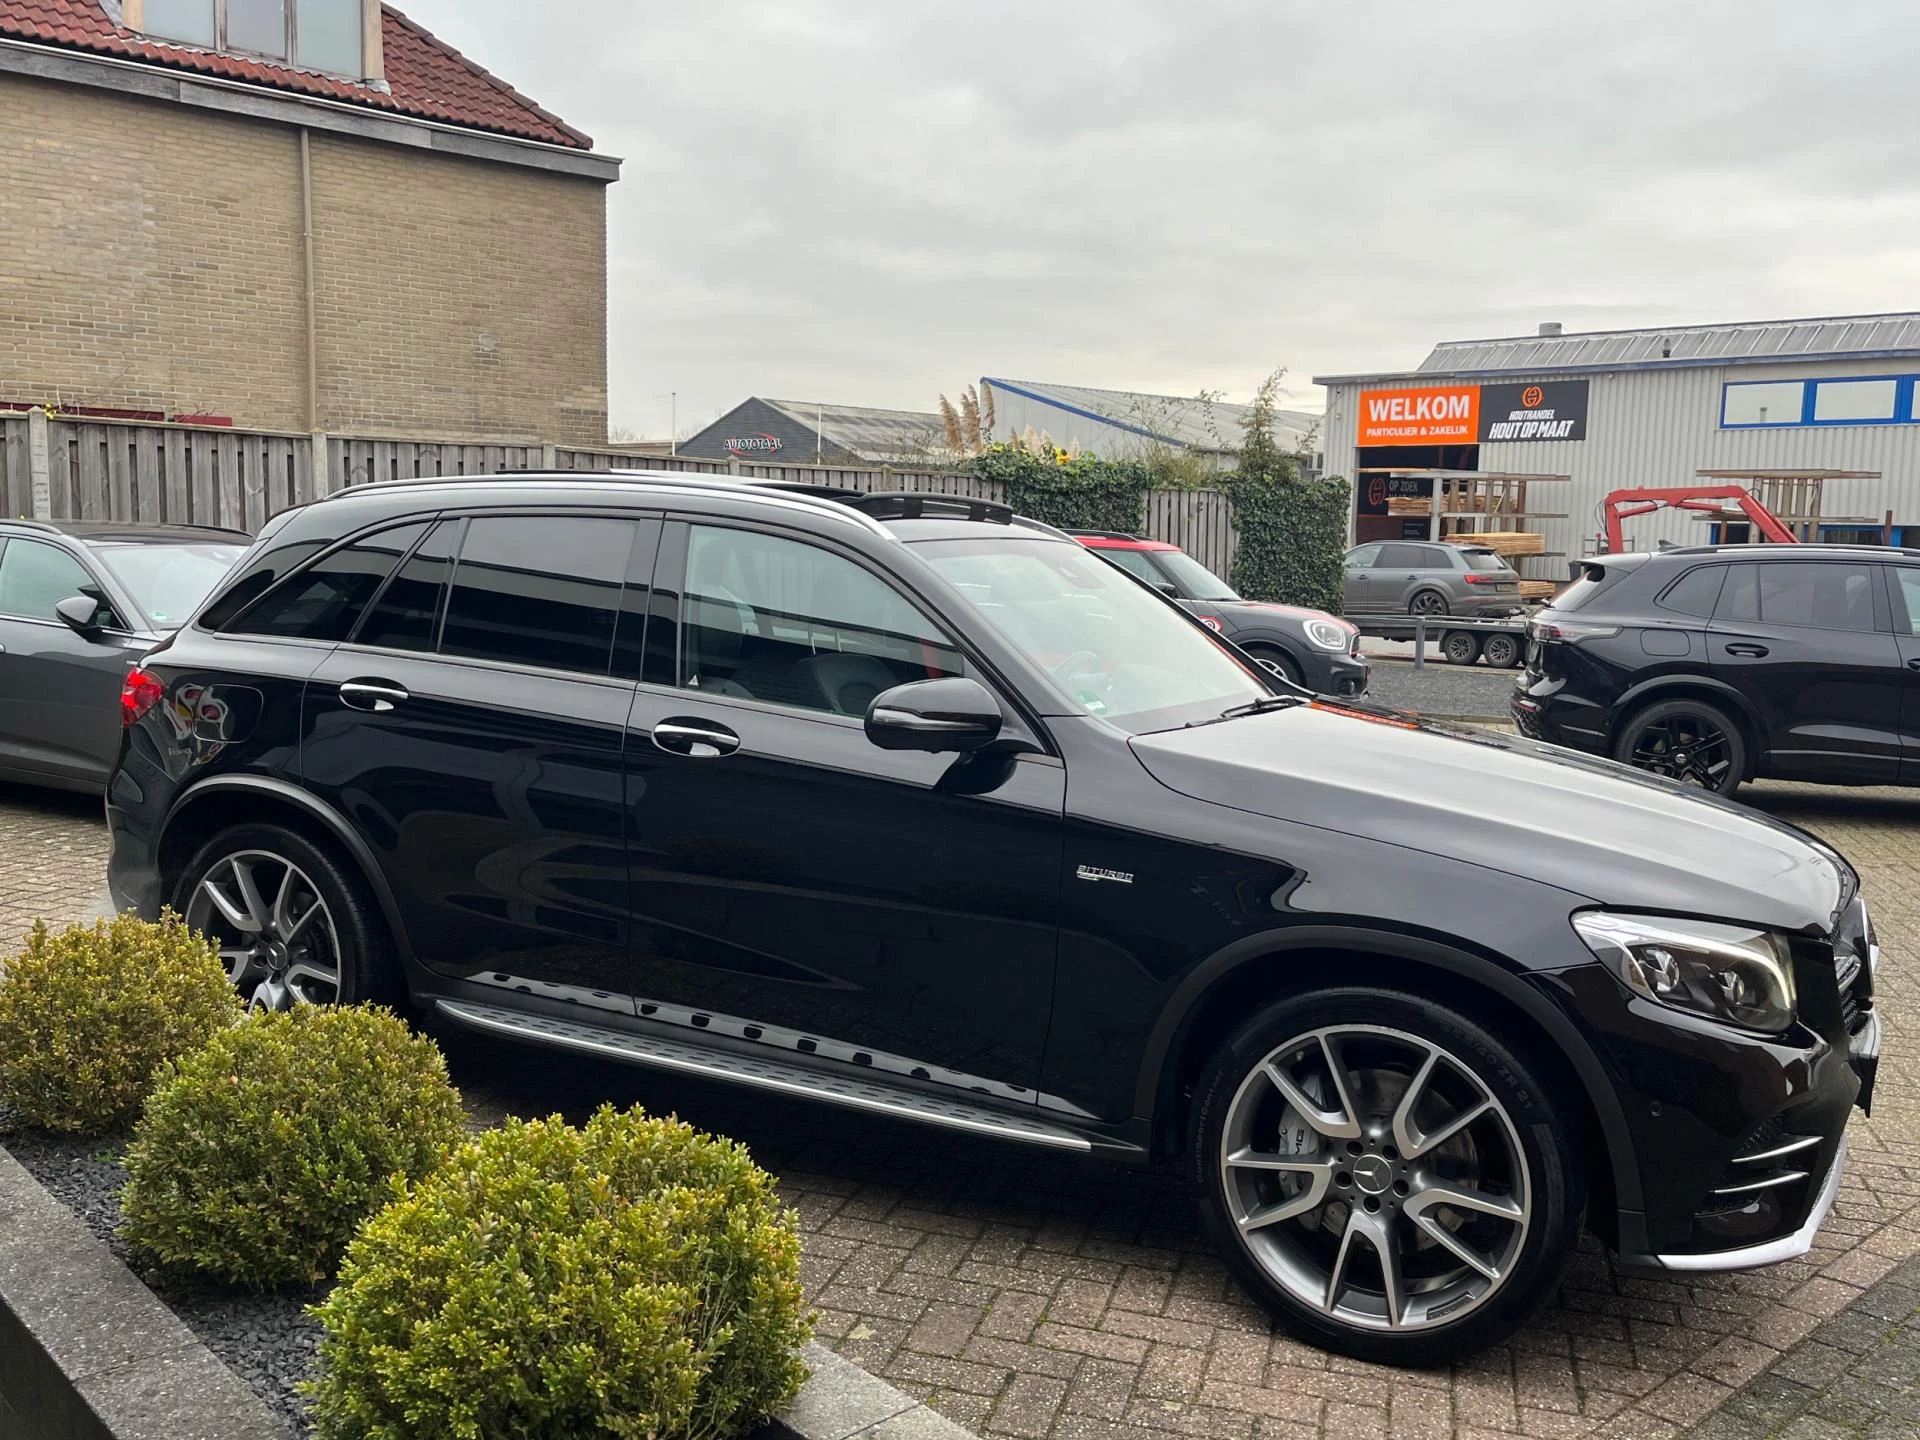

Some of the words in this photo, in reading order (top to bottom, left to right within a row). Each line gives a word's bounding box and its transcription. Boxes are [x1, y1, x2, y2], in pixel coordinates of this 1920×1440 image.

[1369, 395, 1470, 422] WELKOM
[1508, 409, 1555, 421] HOUTHANDEL
[1366, 427, 1418, 437] PARTICULIER
[1420, 427, 1427, 436] &
[1429, 425, 1468, 436] ZAKELIJK
[724, 438, 782, 450] AUTOTOTAAL
[1389, 480, 1399, 491] OP
[1400, 480, 1418, 492] ZOEK
[1078, 864, 1134, 881] BITURBO
[1295, 1128, 1304, 1155] MG
